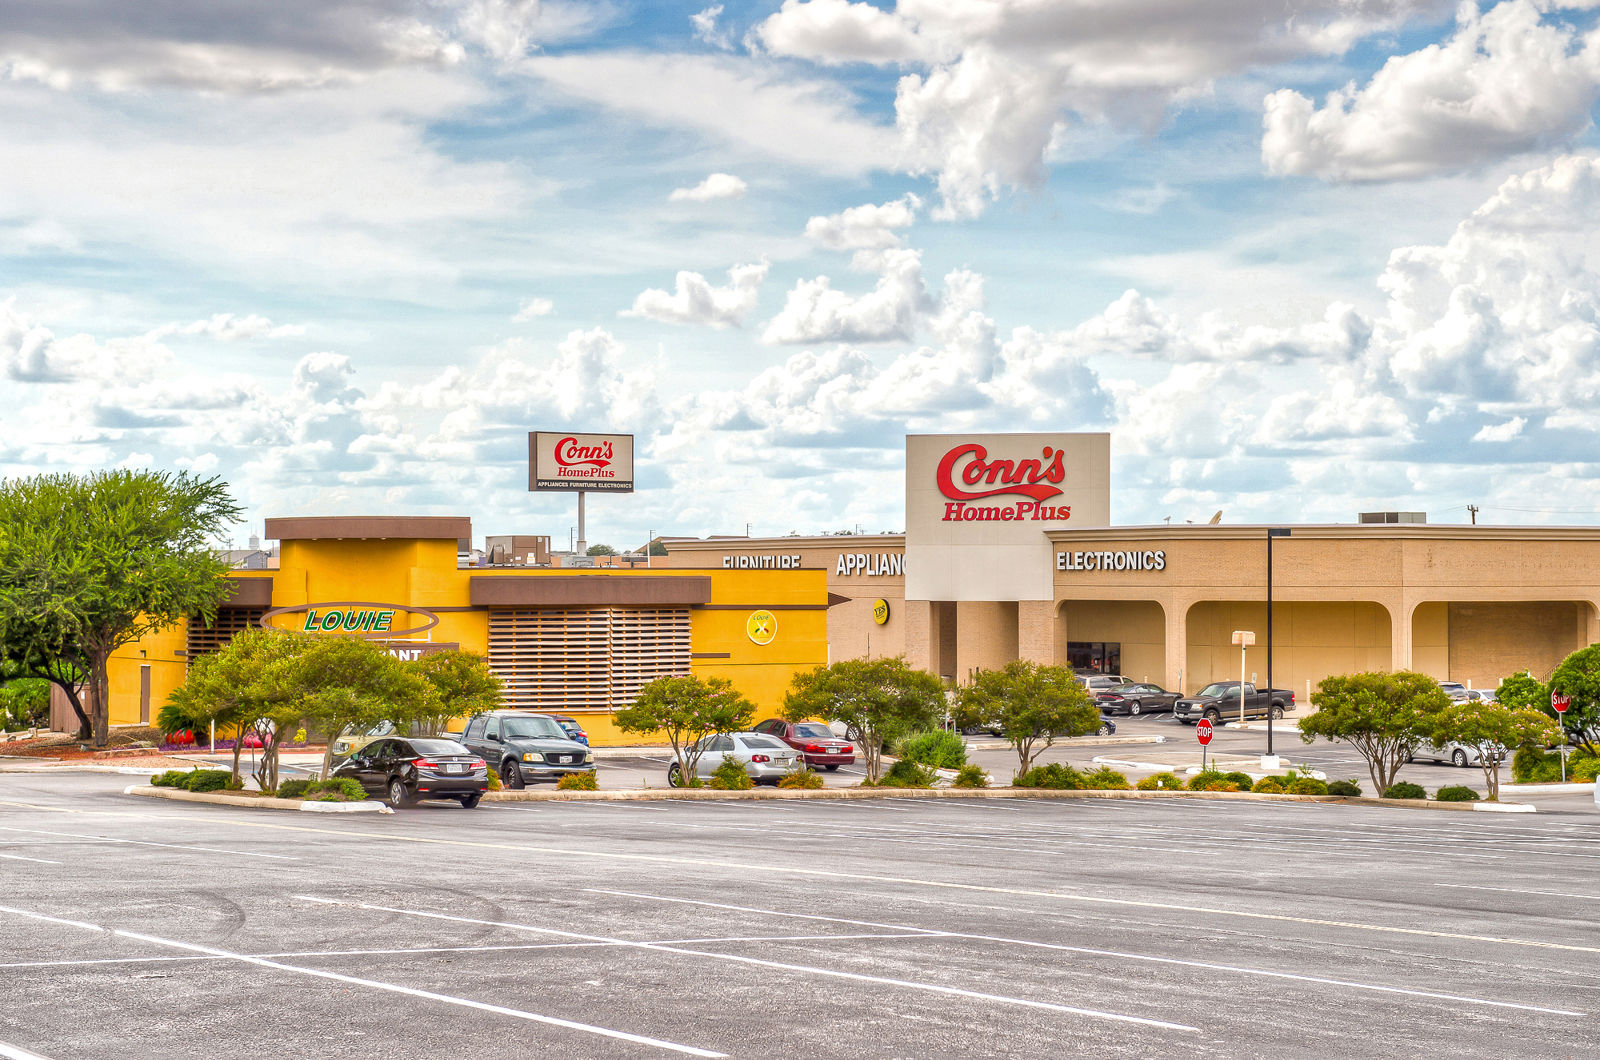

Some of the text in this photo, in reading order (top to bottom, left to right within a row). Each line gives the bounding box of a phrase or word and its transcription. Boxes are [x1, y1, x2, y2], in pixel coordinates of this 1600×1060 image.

[554, 437, 613, 468] Conn's
[558, 467, 615, 478] HomePlus
[936, 443, 1066, 501] Conn's
[942, 501, 1071, 521] HomePlus
[1056, 550, 1166, 570] ELECTRONICS
[303, 610, 395, 632] LOUIE
[1197, 726, 1212, 737] STOP
